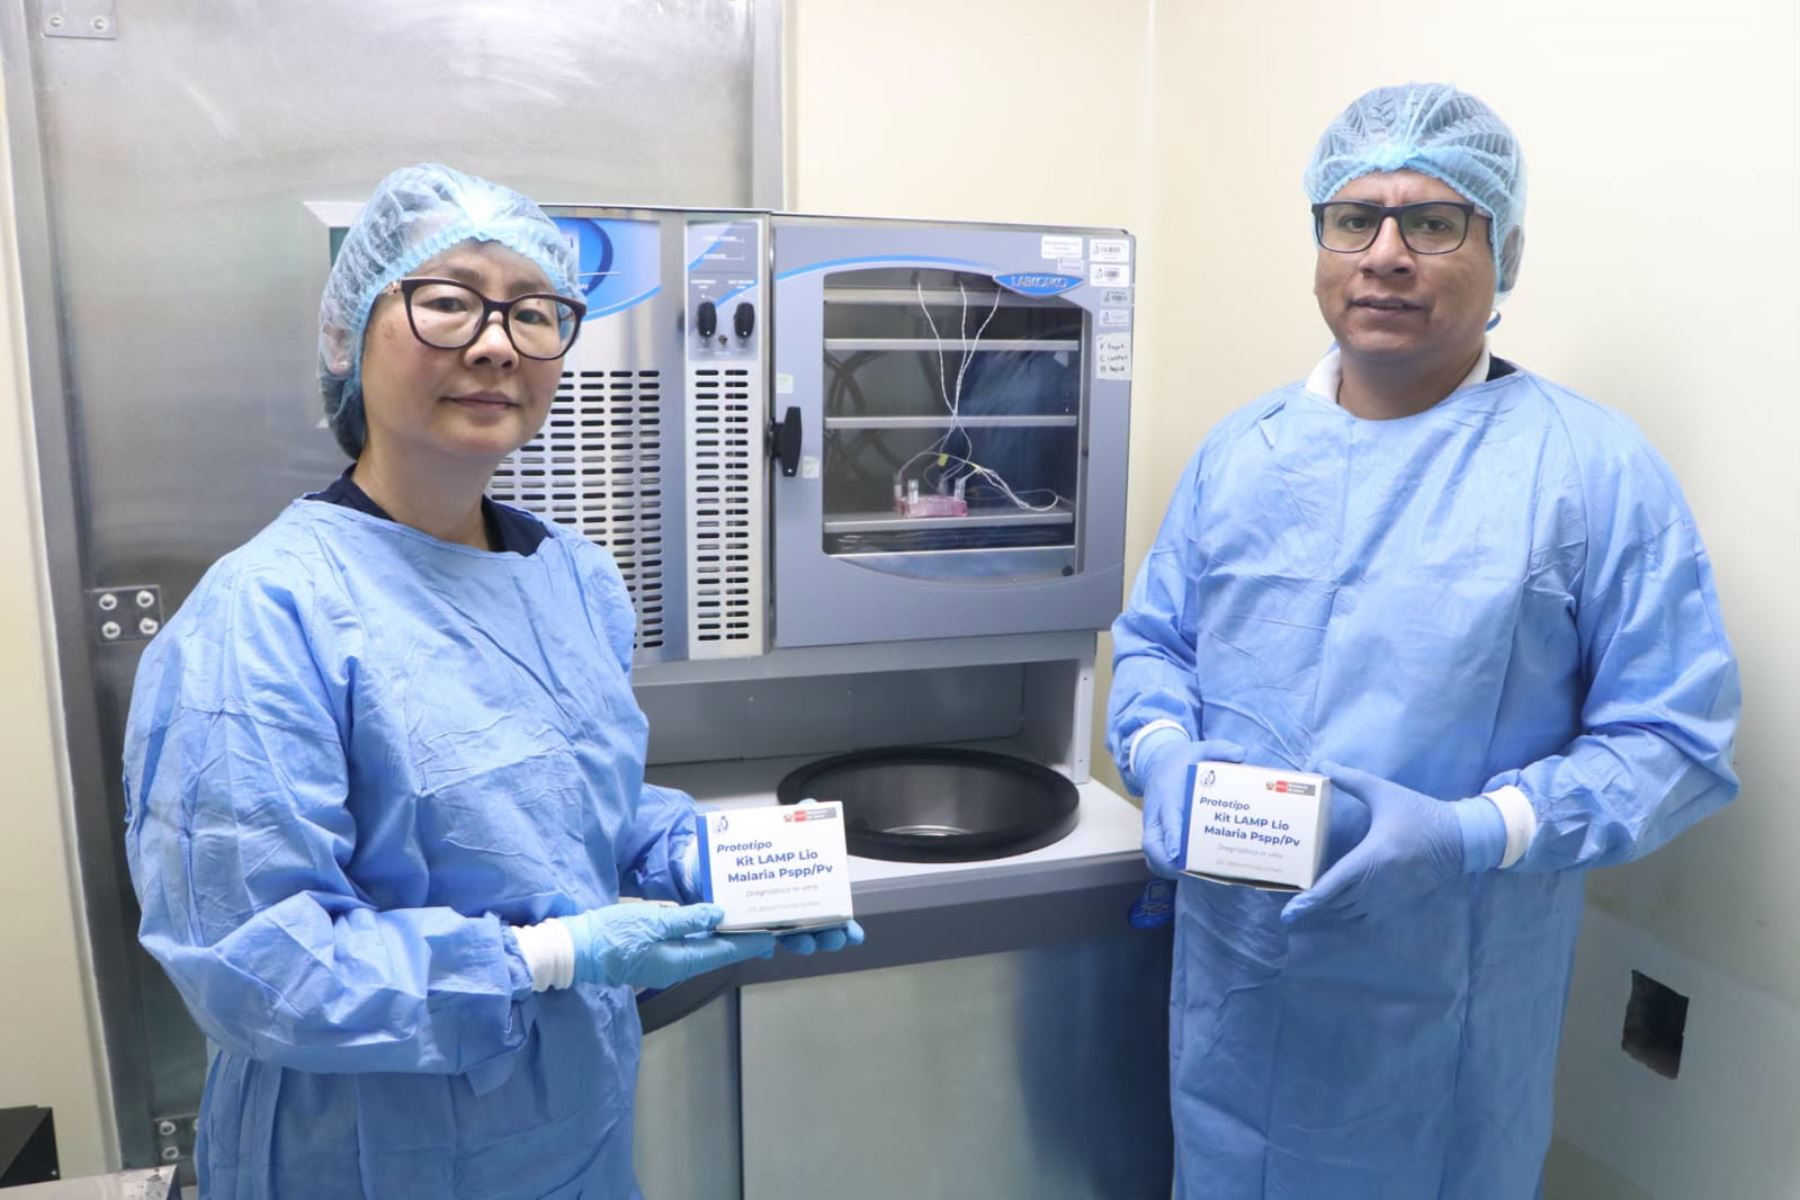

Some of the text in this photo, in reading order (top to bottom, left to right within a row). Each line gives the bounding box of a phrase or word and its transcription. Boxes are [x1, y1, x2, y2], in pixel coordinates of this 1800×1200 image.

[1200, 796, 1250, 811] Prototipo
[1214, 812, 1290, 831] Kit LAMP Lio
[1204, 825, 1301, 847] Malaria Pspp/Pv
[716, 839, 772, 854] Prototipo
[736, 849, 818, 867] Kit LAMP Lio
[727, 863, 833, 883] Malaria Pspp/Pv
